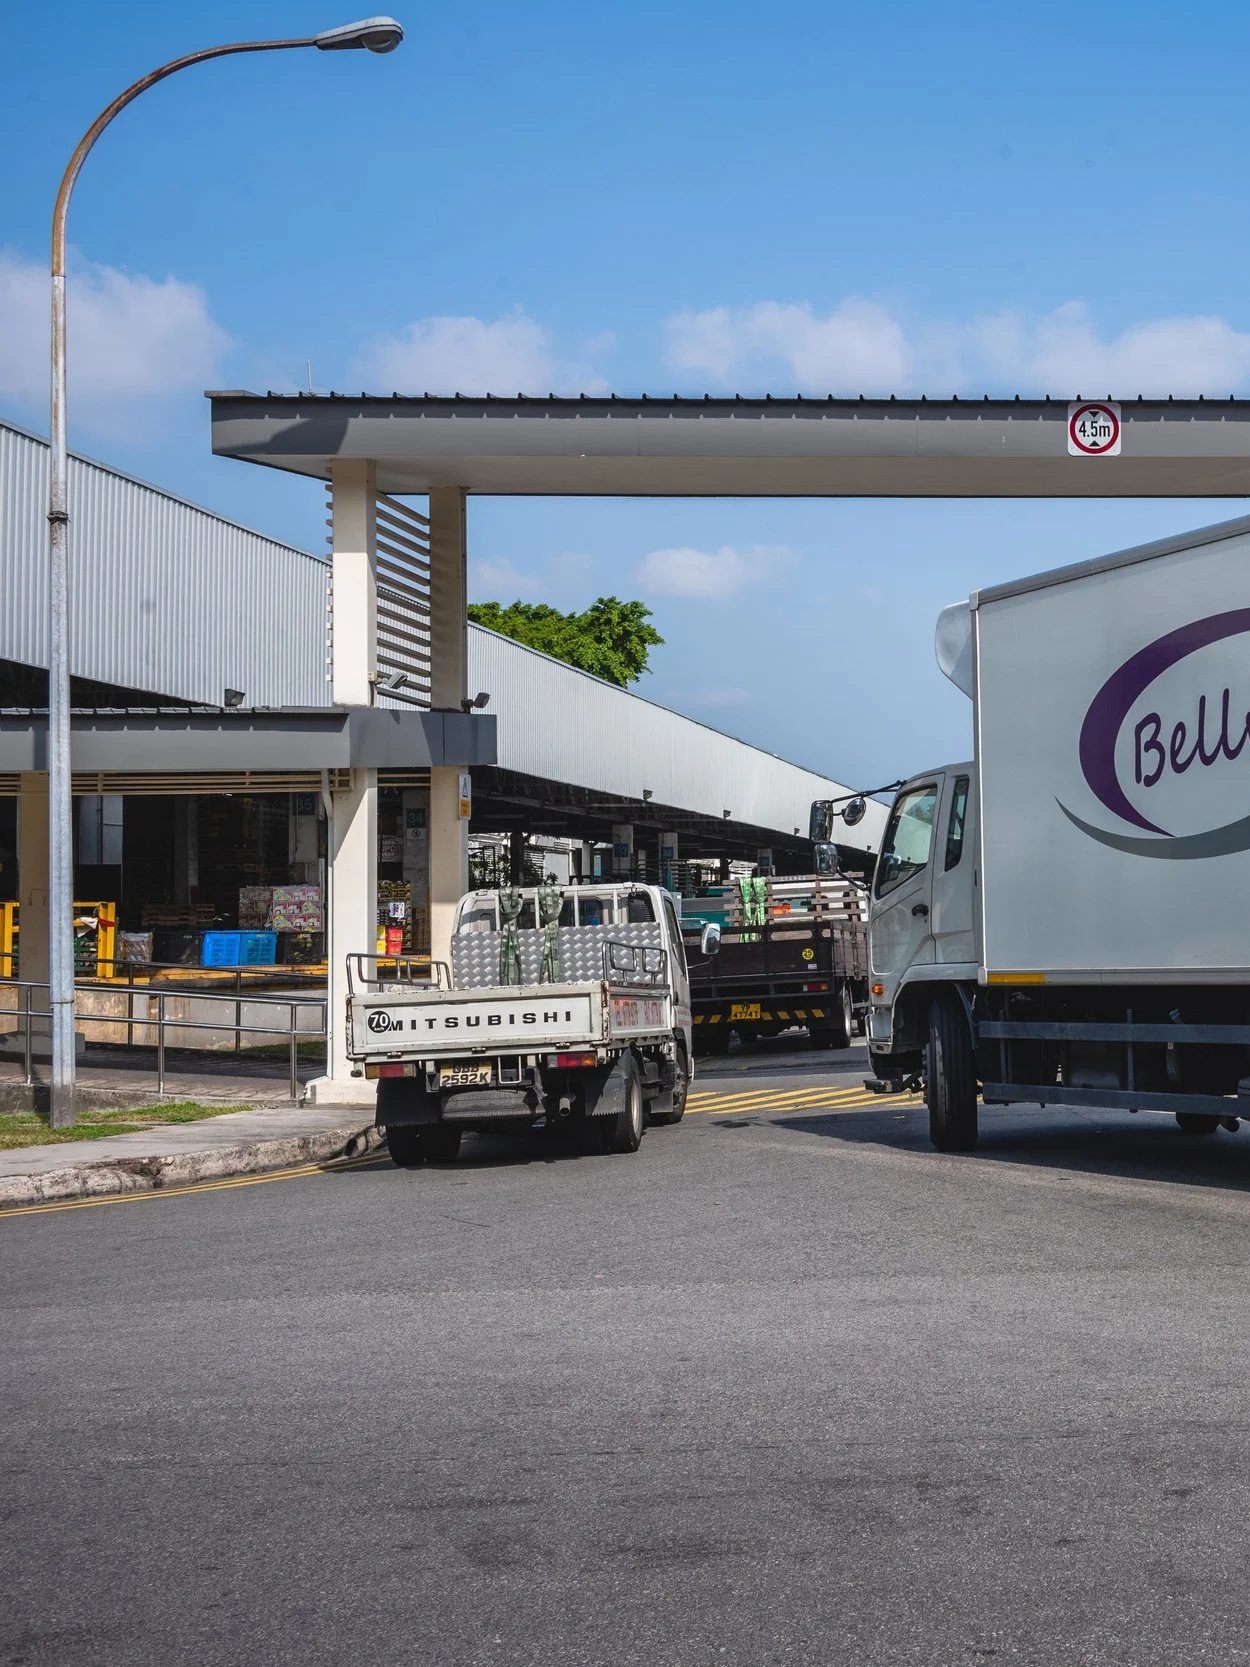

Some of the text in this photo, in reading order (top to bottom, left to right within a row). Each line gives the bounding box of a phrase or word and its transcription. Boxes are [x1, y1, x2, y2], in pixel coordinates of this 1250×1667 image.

[1079, 420, 1110, 437] 4.5m
[408, 812, 423, 823] 34
[370, 1013, 389, 1028] 70
[388, 1011, 571, 1031] MITSUBISHI
[442, 1072, 489, 1085] 2592K
